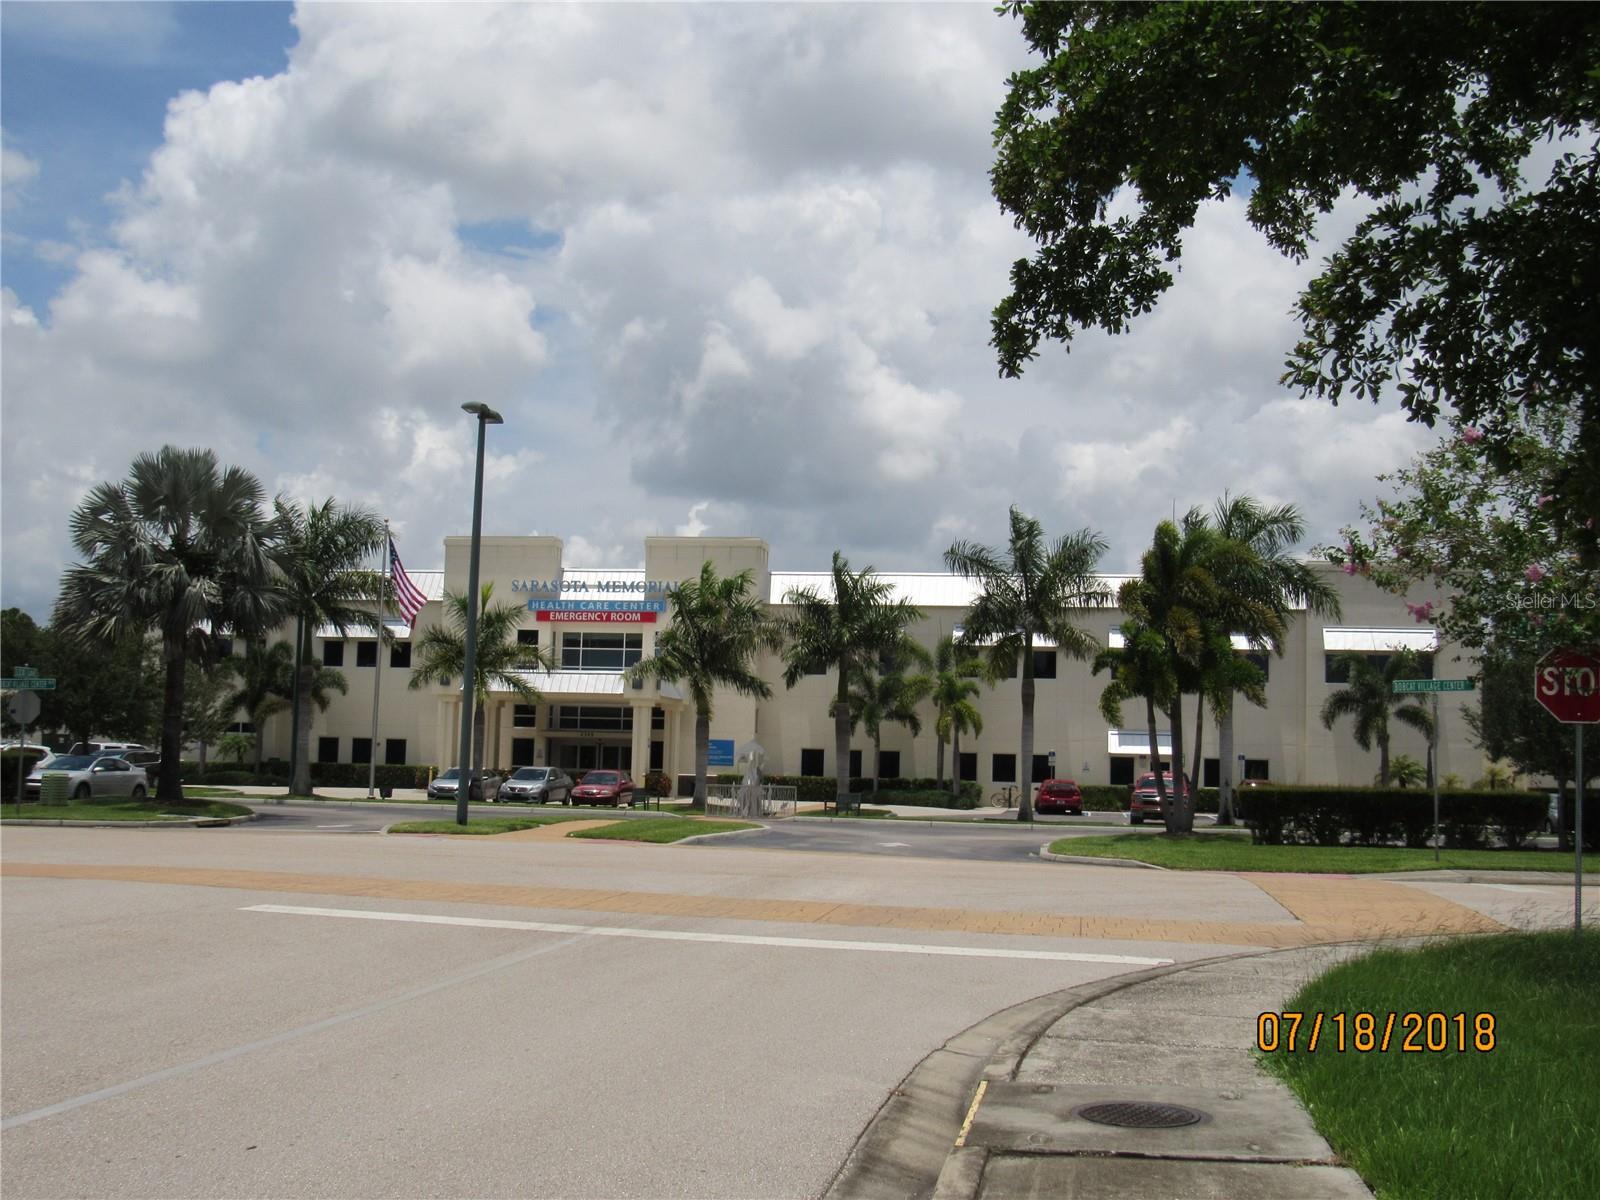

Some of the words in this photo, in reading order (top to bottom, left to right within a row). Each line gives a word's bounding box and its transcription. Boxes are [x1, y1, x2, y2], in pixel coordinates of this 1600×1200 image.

[511, 579, 590, 594] SARASOTA
[597, 580, 681, 594] MEMORIAL
[531, 601, 575, 610] HEALTH
[580, 601, 609, 610] CARE
[615, 602, 660, 611] CENTER
[550, 612, 607, 622] EMERGENCY
[610, 612, 641, 622] ROOM
[1394, 681, 1416, 691] BOBCAT
[1417, 681, 1441, 691] VILLAGE
[1443, 681, 1465, 690] CENTER
[1541, 666, 1600, 696] STO
